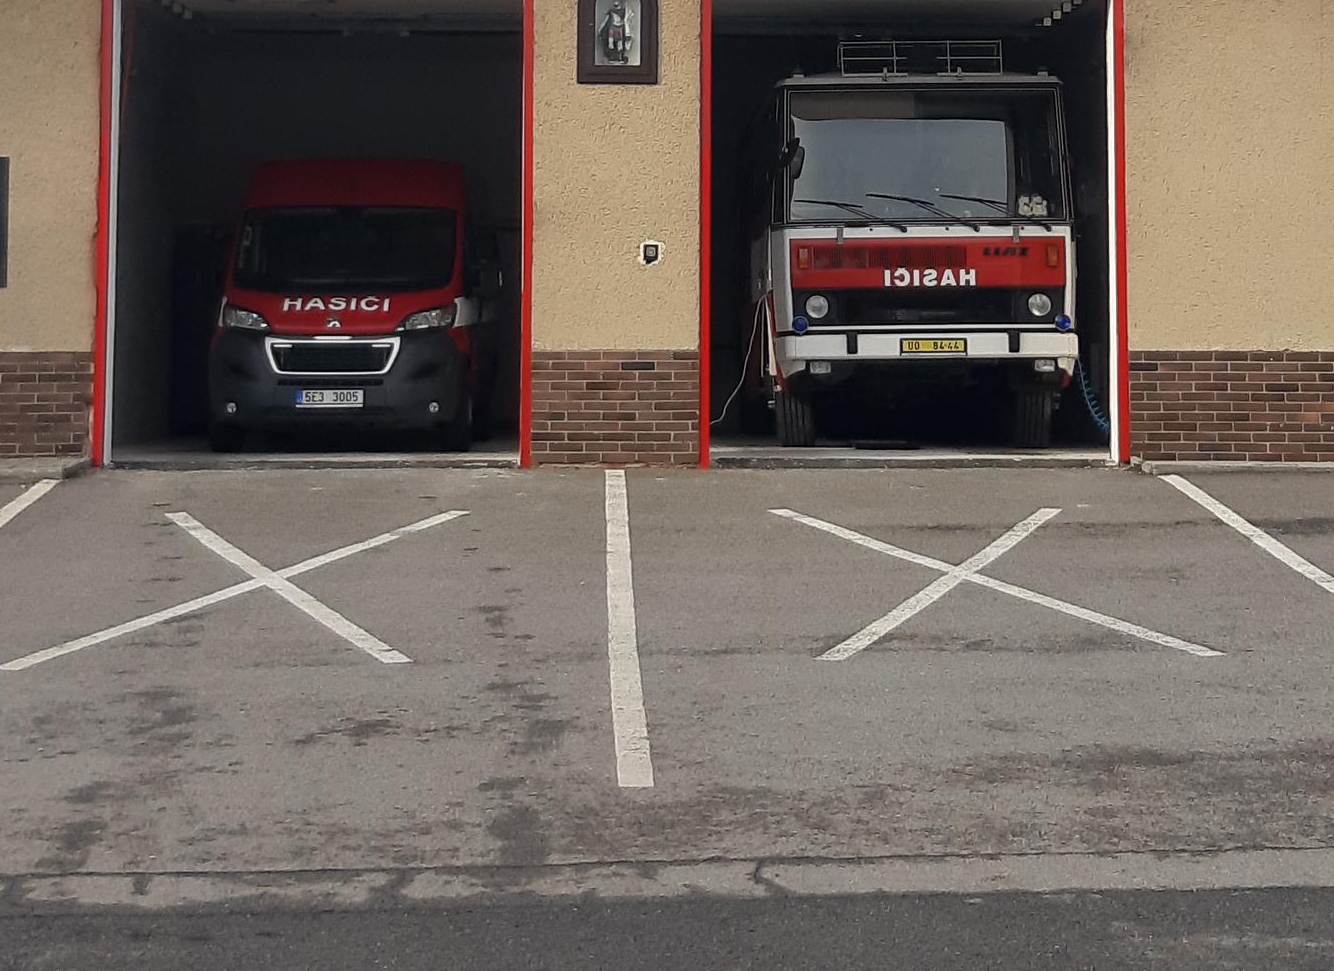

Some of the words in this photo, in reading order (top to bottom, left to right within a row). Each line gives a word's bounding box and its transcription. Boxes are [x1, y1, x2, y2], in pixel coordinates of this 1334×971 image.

[282, 296, 391, 312] HASIČI
[304, 391, 325, 403] 5E3
[332, 391, 359, 403] 3005
